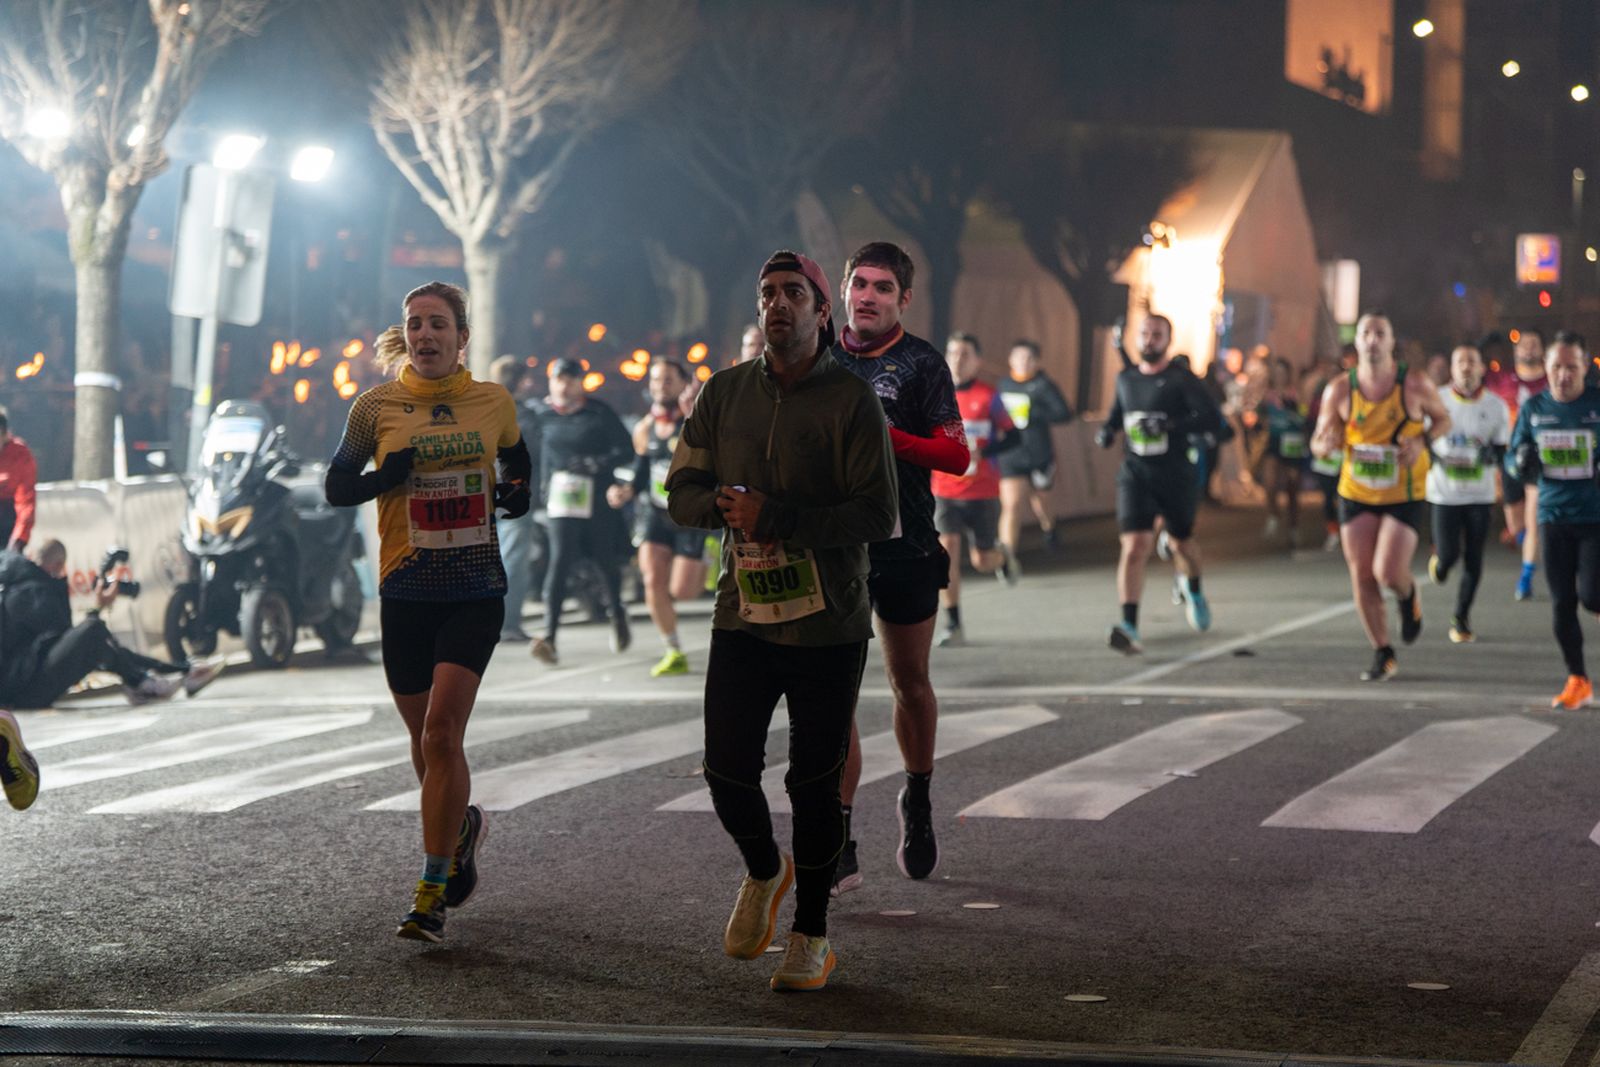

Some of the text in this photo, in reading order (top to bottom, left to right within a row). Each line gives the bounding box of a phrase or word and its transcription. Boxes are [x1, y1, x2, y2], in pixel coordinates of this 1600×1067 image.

[410, 431, 482, 446] CANILLAS DE
[412, 441, 485, 460] ALBAIDA
[423, 479, 459, 489] NOCHE DE
[424, 497, 471, 523] 1102
[746, 565, 800, 596] 1390
